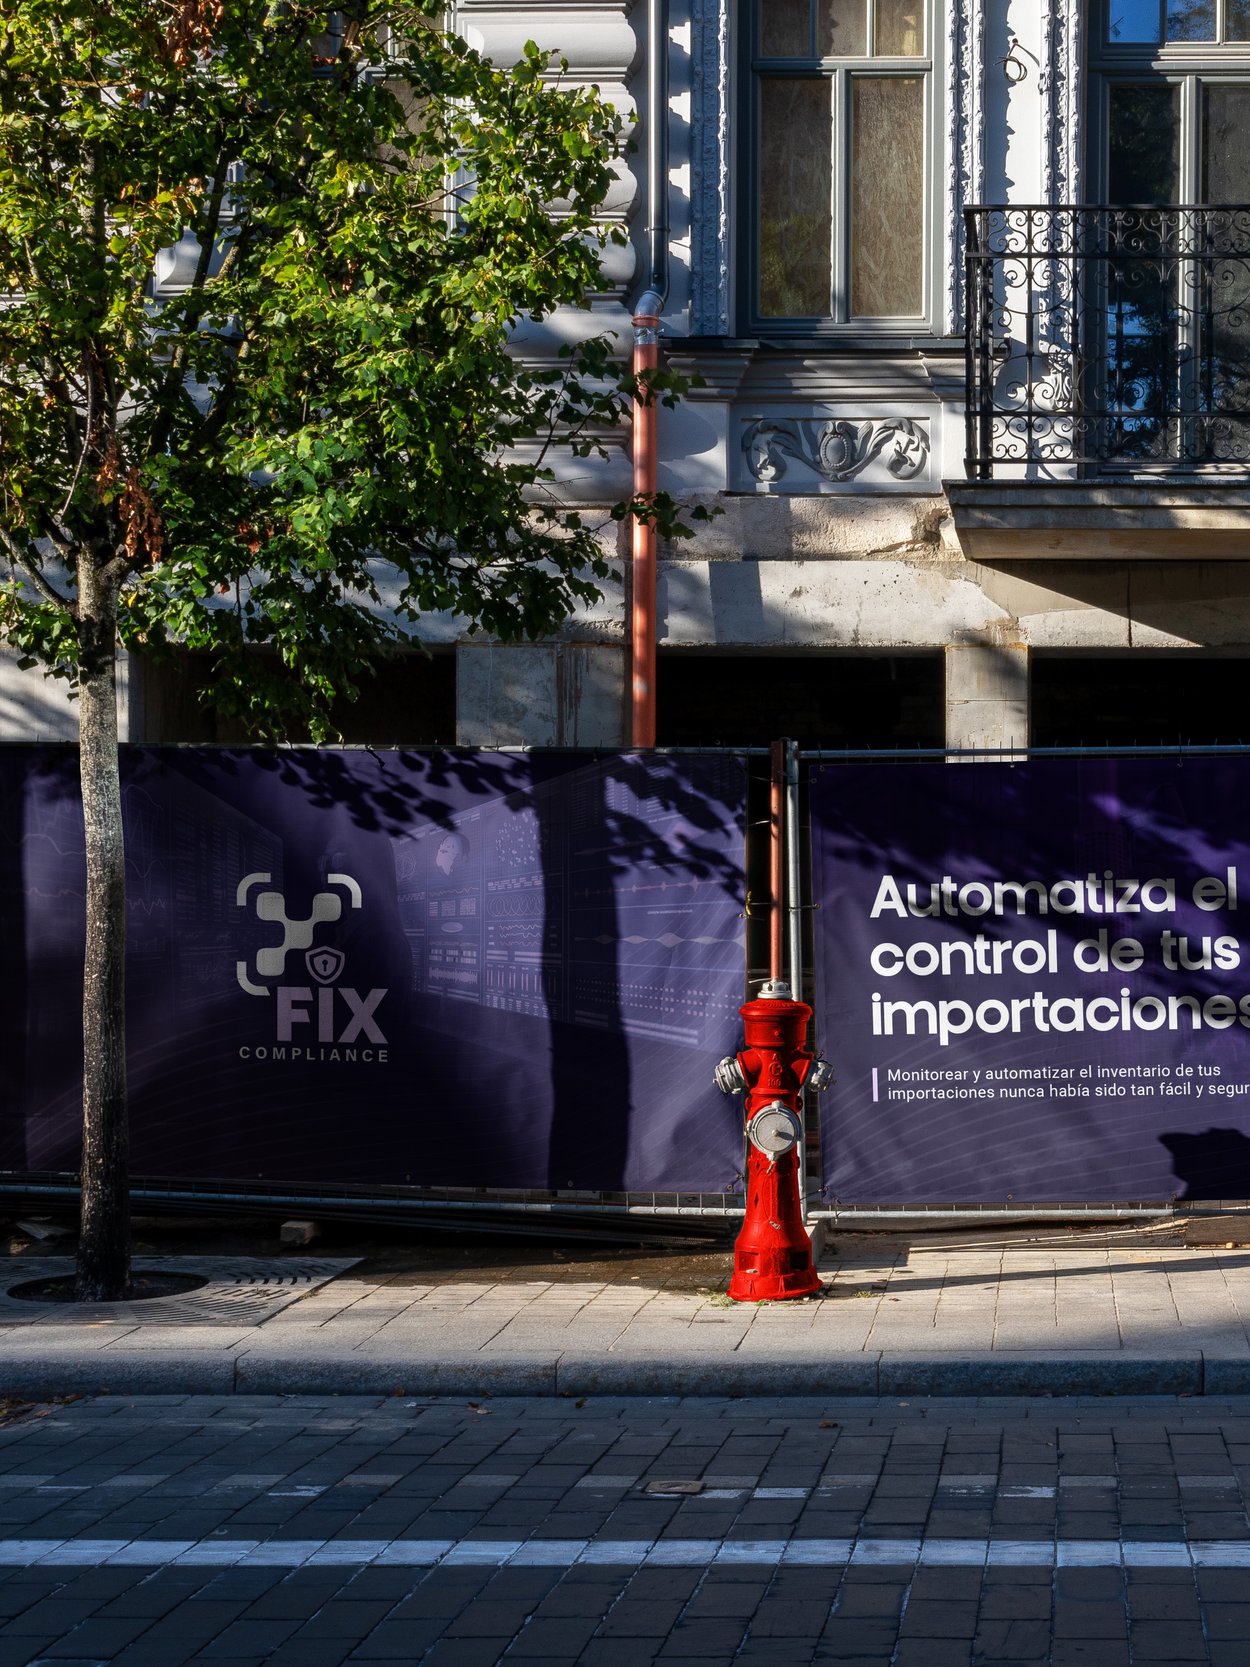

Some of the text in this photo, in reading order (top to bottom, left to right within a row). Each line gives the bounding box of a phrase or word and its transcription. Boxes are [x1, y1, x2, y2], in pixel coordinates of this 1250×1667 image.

[869, 866, 1239, 919] Automatiza el
[869, 928, 1241, 978] control de tus
[276, 986, 389, 1044] FIX
[238, 1046, 388, 1063] COMPLIANCE
[887, 1063, 1222, 1084] Monitorear y automatizar el inventario de tus
[887, 1086, 996, 1103] importaciones
[999, 1087, 1045, 1099] nunca
[1048, 1081, 1091, 1099] había
[1094, 1082, 1127, 1097] sido
[1130, 1083, 1155, 1097] tan
[1158, 1080, 1191, 1096] fácil
[1195, 1084, 1204, 1099] y
